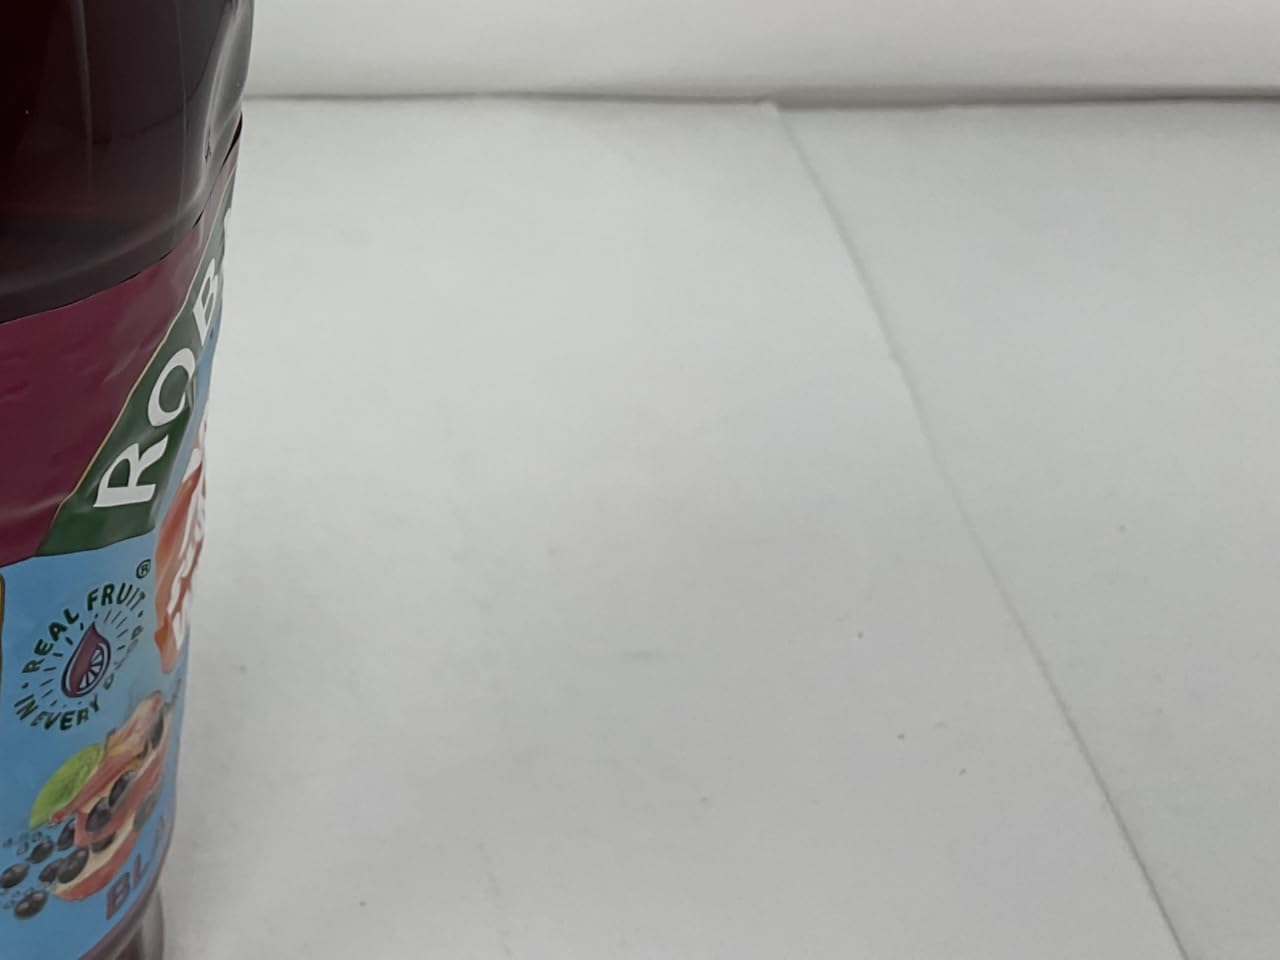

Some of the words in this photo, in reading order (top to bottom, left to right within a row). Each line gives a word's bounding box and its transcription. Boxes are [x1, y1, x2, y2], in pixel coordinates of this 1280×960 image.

[22, 608, 80, 673] REAL
[87, 582, 146, 612] FRUIT
[14, 694, 38, 720] IN
[31, 695, 100, 731] EVERY
